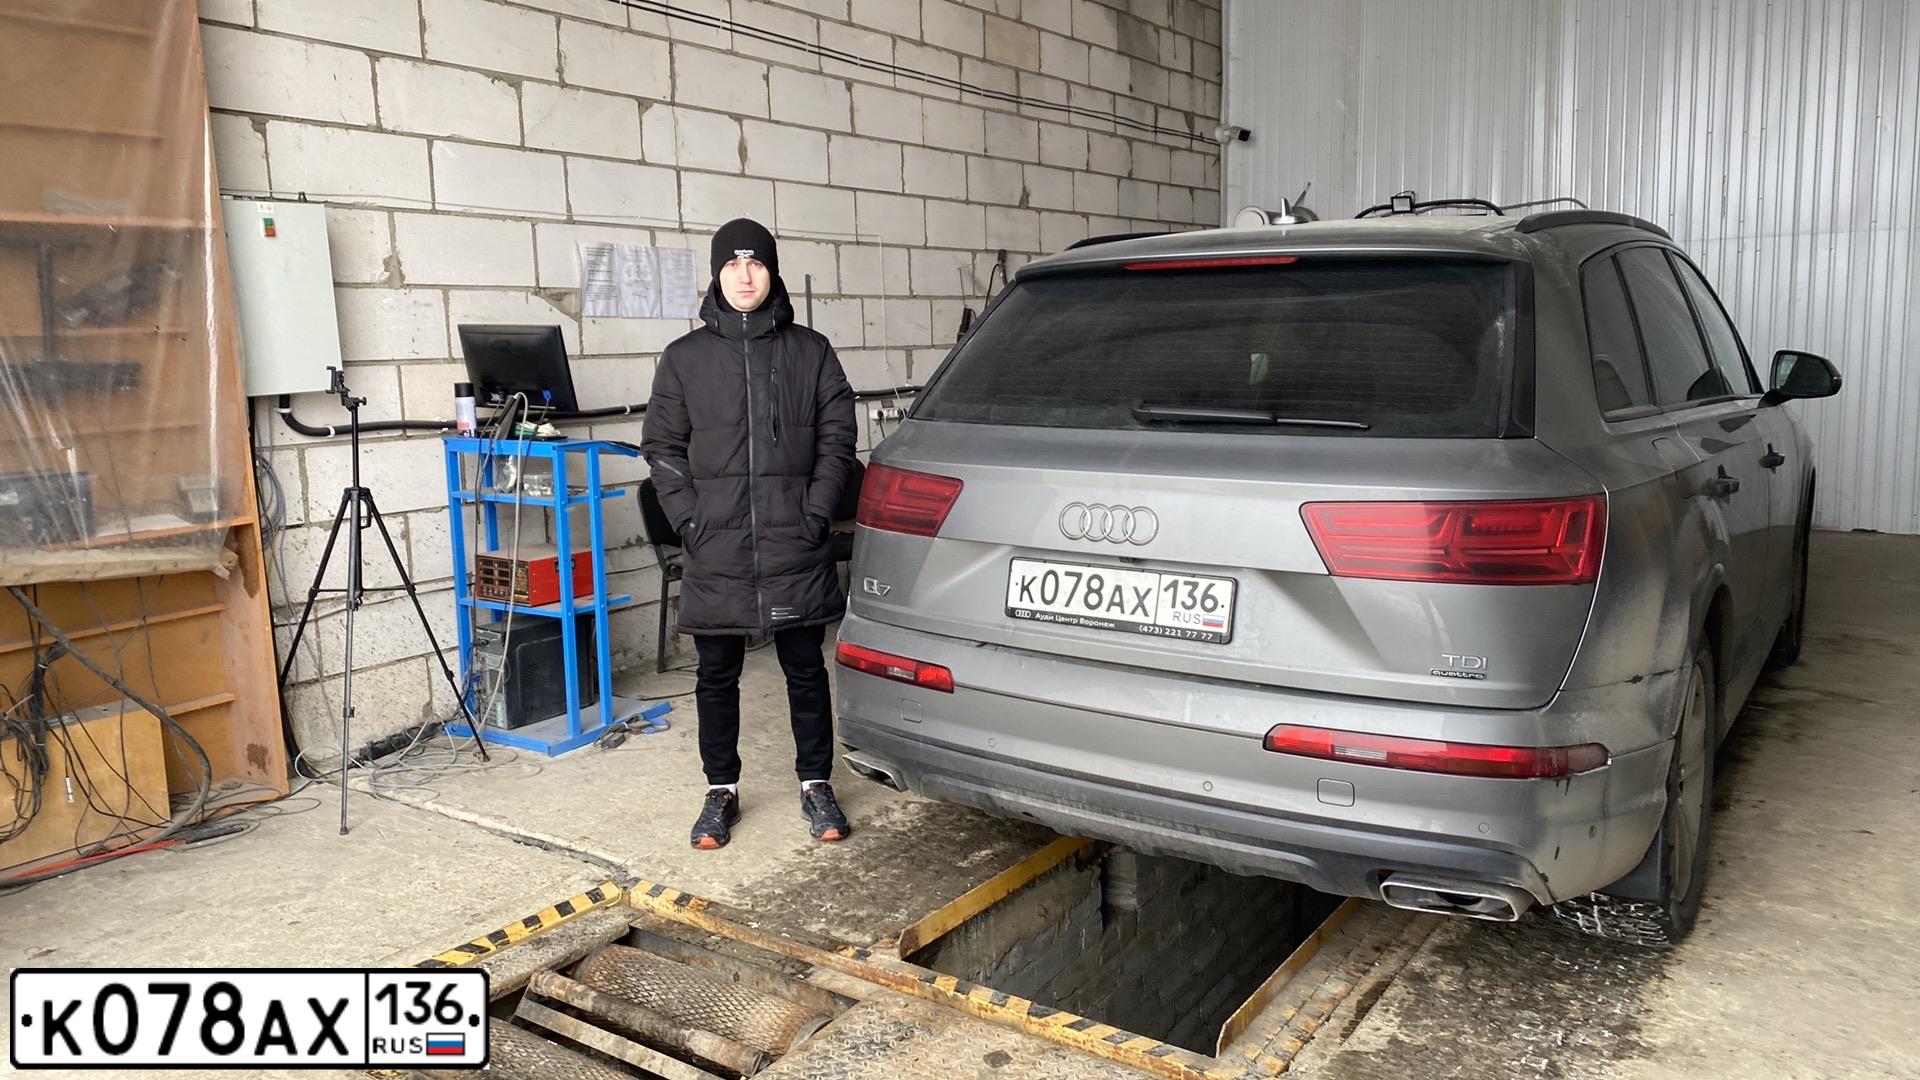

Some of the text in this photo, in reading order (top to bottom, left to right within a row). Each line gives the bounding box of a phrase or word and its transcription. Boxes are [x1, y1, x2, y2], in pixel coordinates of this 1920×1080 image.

[1162, 578, 1219, 614] 136
[1034, 612, 1115, 628] Ауди Центр Воронеж
[1172, 610, 1201, 625] RUS
[1139, 624, 1213, 640] (473) 221 77 77
[1441, 654, 1488, 670] TDI
[1431, 669, 1485, 679] quattro
